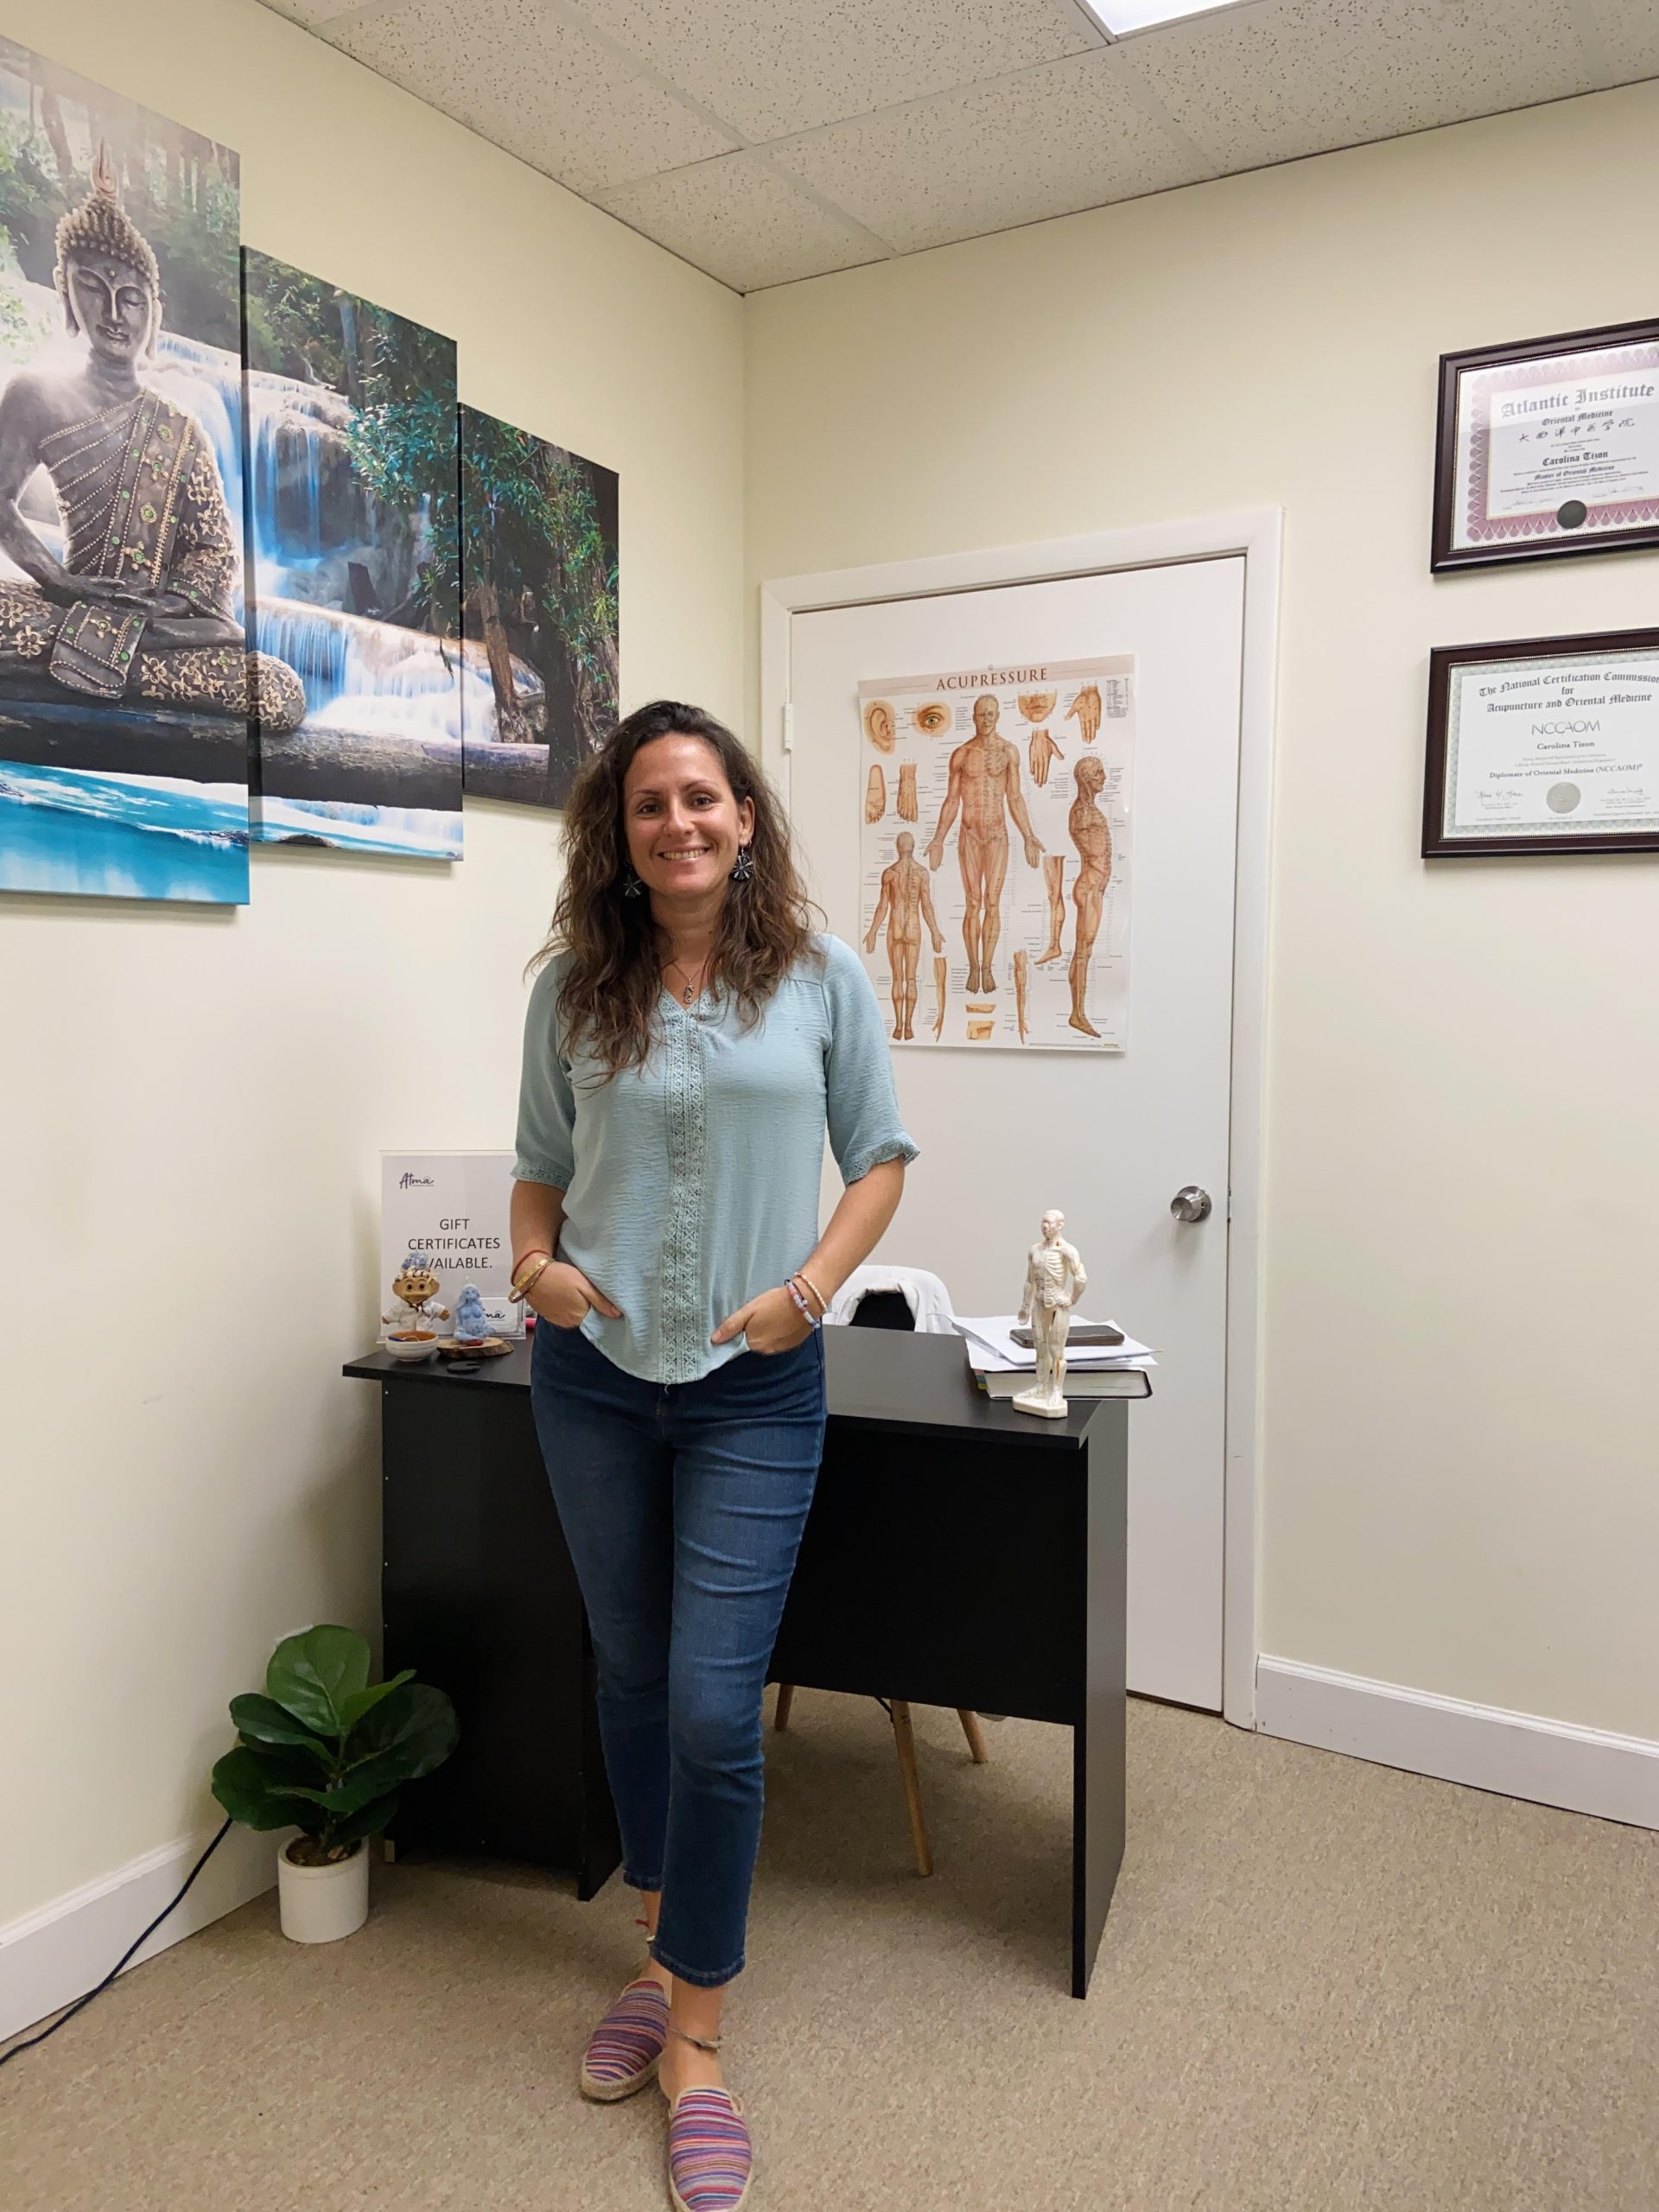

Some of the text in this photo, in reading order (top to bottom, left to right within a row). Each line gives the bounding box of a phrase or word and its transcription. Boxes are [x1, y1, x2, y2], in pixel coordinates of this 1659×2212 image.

[1501, 384, 1655, 418] Atlantic Institute
[1541, 410, 1613, 426] Oriental Medicine
[1542, 455, 1580, 467] Carolina
[1583, 451, 1609, 462] Tizon
[936, 668, 1048, 690] ACUPRESSURE
[1479, 687, 1497, 697] The
[1500, 677, 1540, 693] National
[1543, 672, 1600, 685] Certification
[1561, 687, 1574, 696] for
[1486, 693, 1652, 713] Acupuncture and Oriental Medicine
[1531, 720, 1601, 735] NCCAOM
[1536, 742, 1571, 751] Carolina
[399, 1173, 435, 1189] Atma
[439, 1219, 470, 1230] GIFT
[408, 1237, 500, 1250] CERTIFICATES
[429, 1257, 493, 1269] VAILABLE.
